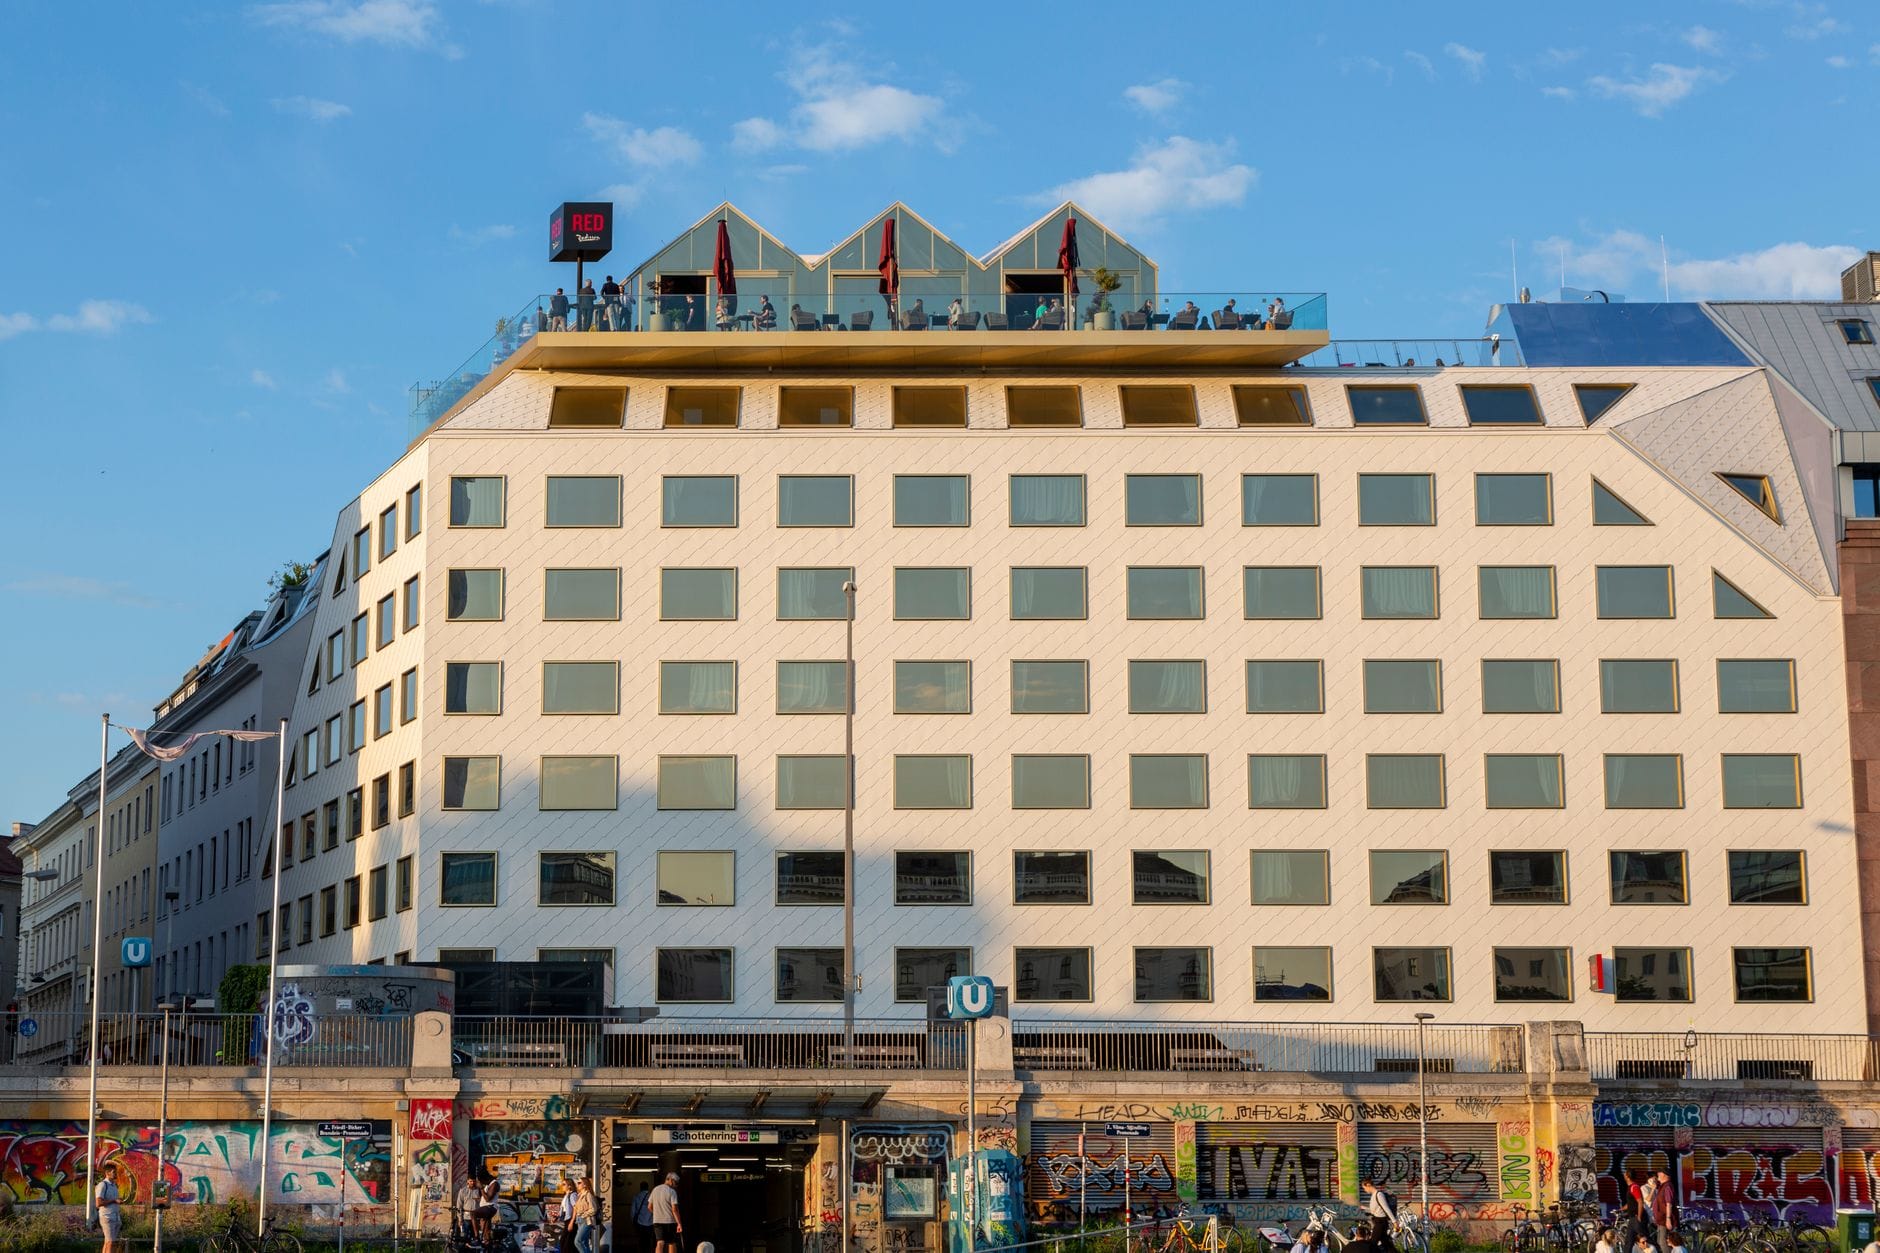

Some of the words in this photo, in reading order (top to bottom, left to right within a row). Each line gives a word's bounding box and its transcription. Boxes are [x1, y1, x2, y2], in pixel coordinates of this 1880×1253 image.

[572, 213, 605, 232] RED
[127, 943, 146, 963] U
[962, 984, 988, 1013] U
[671, 1131, 737, 1142] Schottenring
[739, 1132, 748, 1141] U2
[751, 1132, 760, 1141] U4
